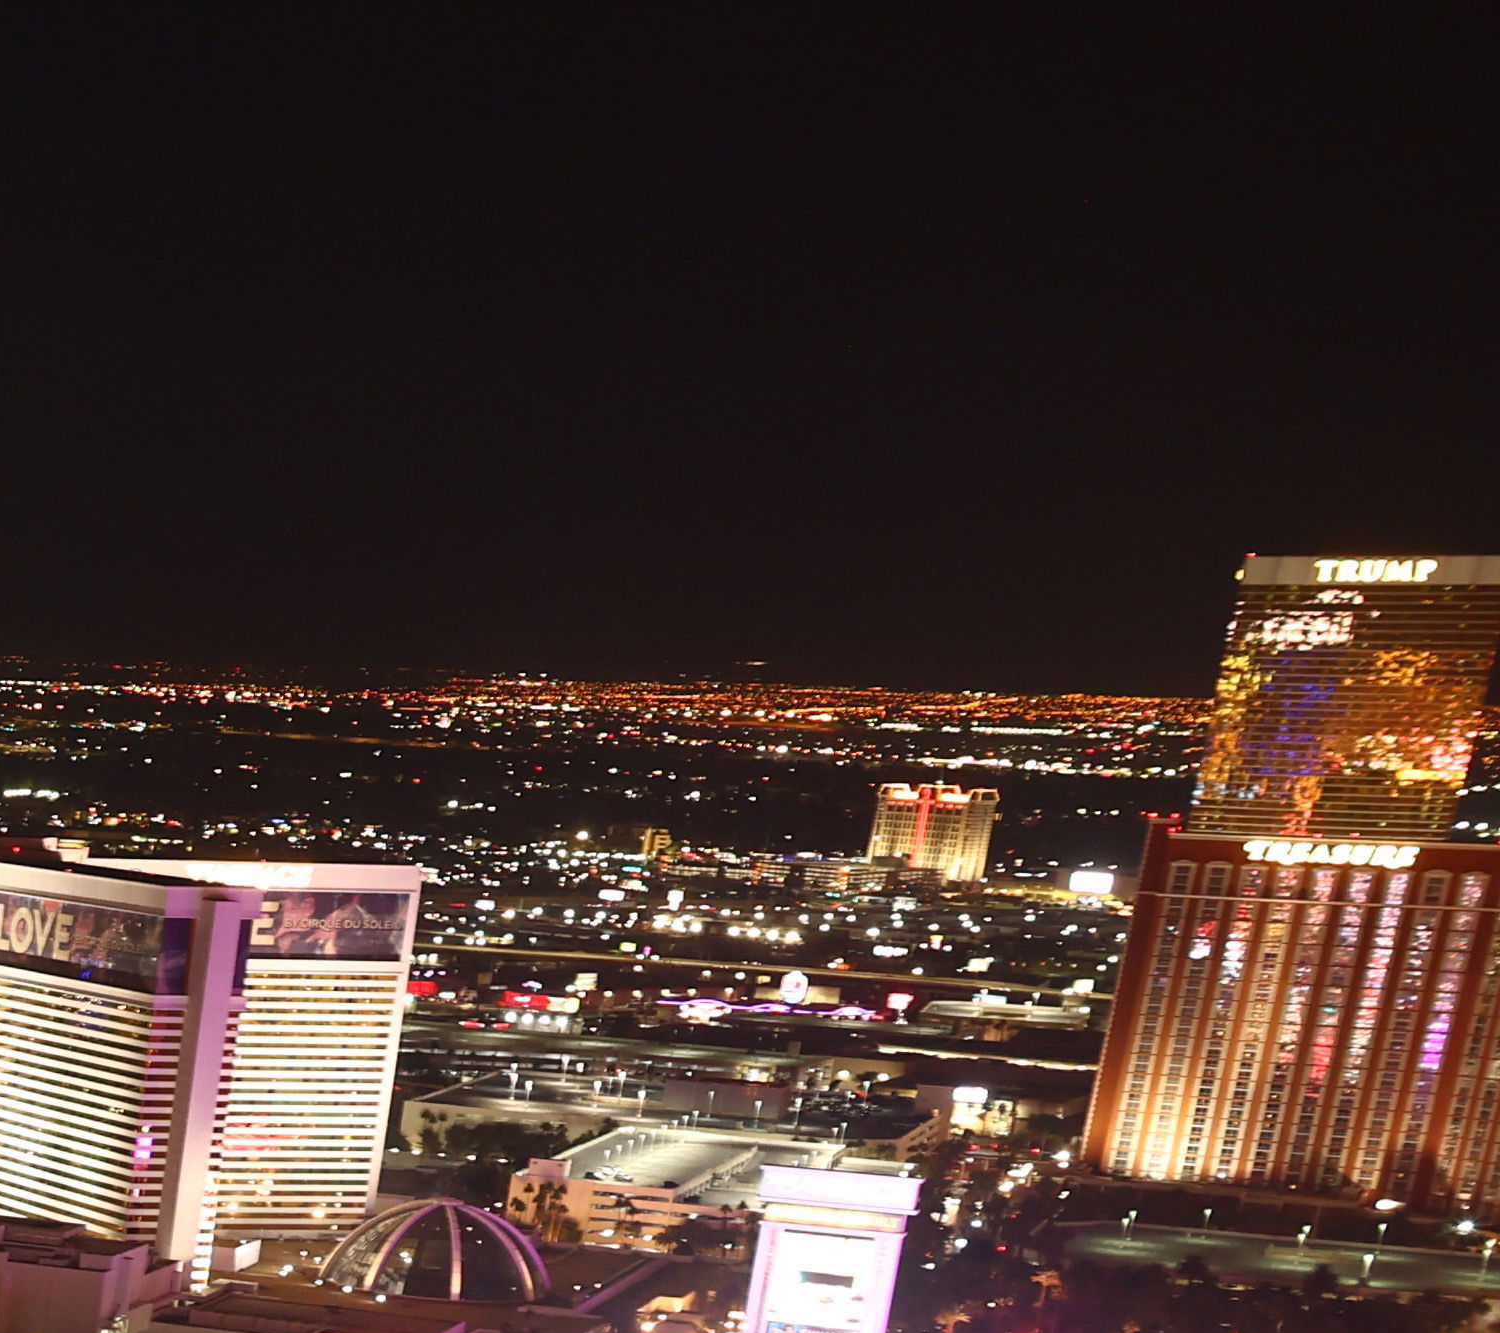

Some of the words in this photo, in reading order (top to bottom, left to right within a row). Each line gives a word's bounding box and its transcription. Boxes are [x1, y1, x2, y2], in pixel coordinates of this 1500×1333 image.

[1314, 559, 1438, 582] TRUMP
[1243, 840, 1420, 869] TREASURE
[284, 919, 299, 930] BY
[301, 919, 343, 930] CIRQUE
[344, 919, 360, 930] DU
